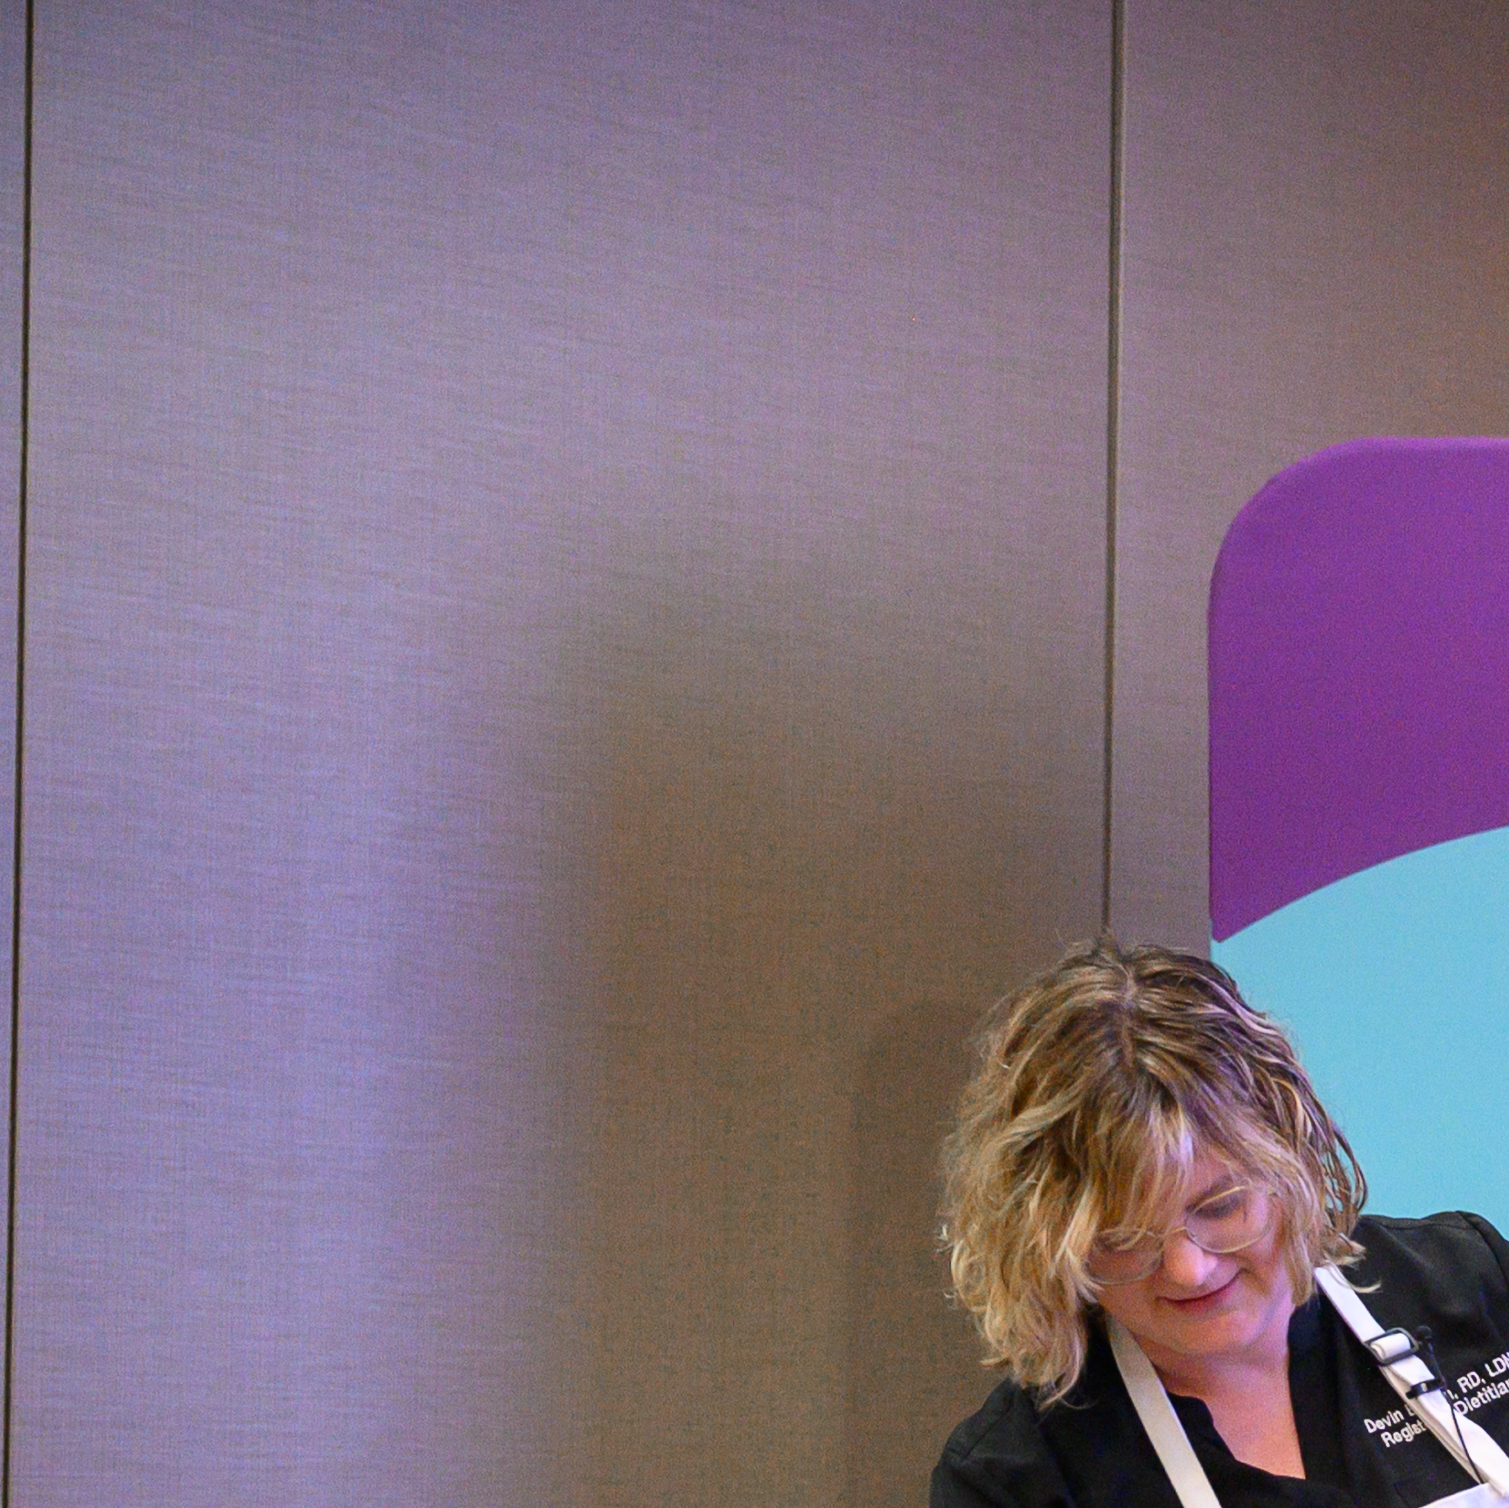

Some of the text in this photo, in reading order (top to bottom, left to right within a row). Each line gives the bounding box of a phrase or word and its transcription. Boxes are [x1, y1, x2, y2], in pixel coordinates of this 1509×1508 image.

[1364, 1408, 1405, 1434] Devin
[1457, 1371, 1487, 1394] RD,
[1380, 1420, 1428, 1448] Regist
